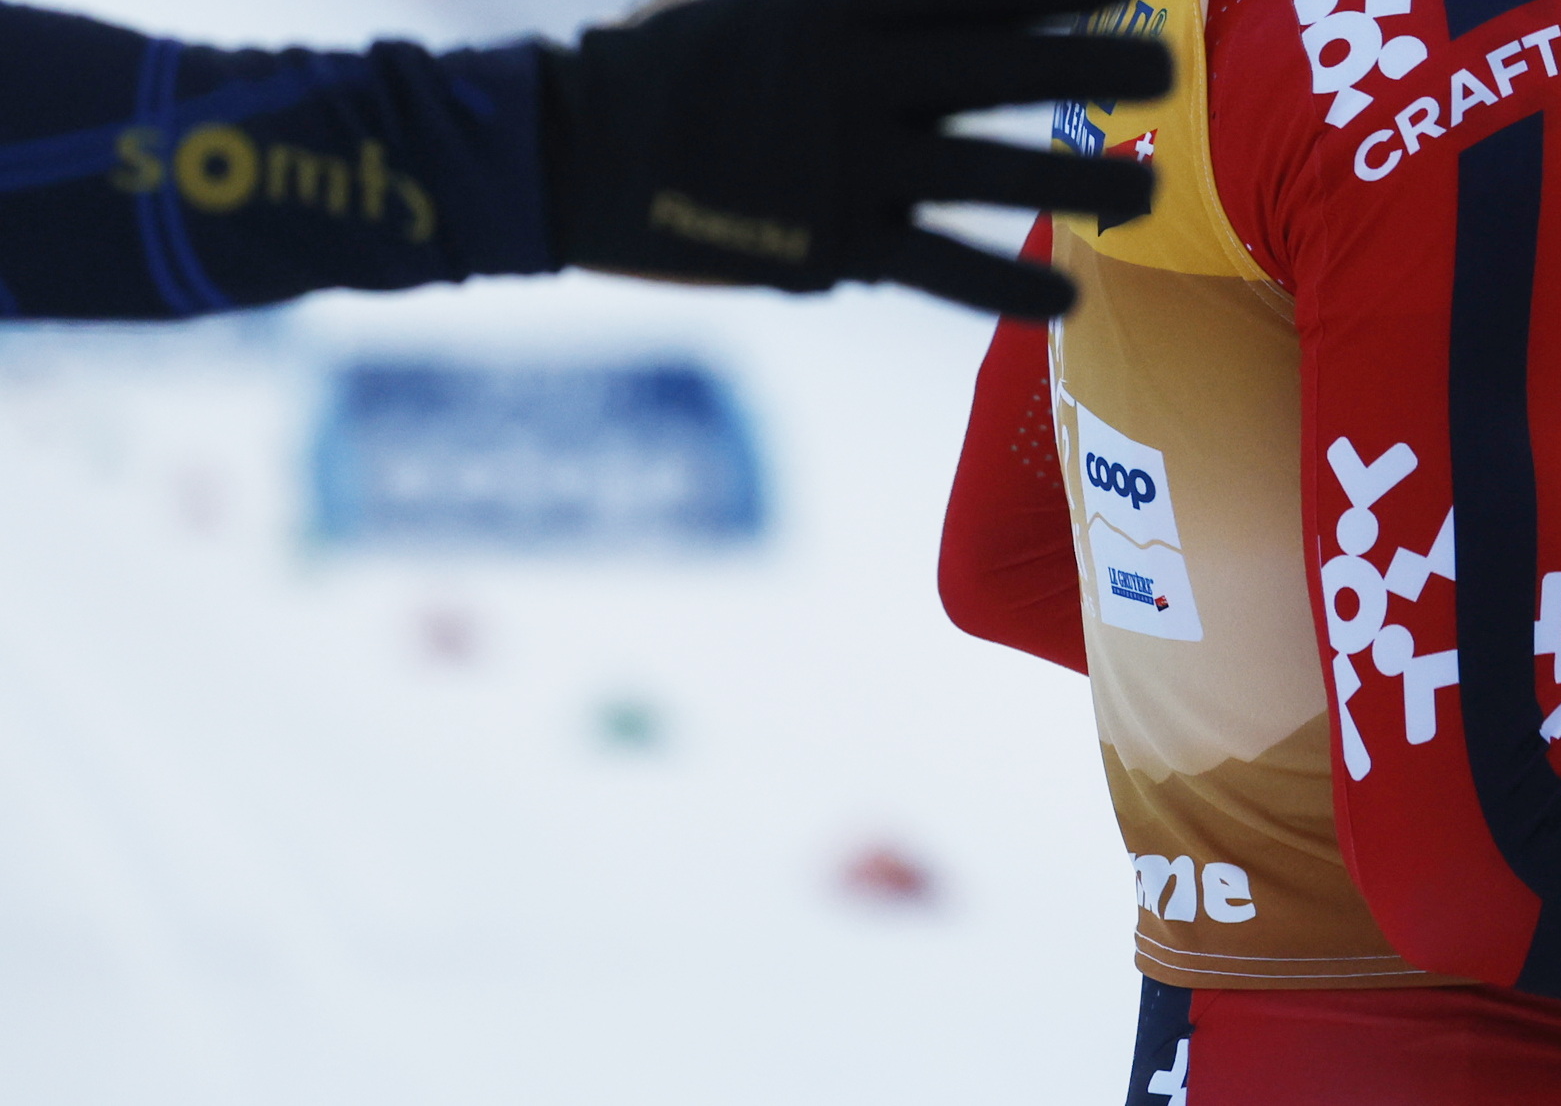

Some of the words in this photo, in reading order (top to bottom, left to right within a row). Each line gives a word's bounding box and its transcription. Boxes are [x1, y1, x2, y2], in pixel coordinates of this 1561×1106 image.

[1354, 24, 1561, 183] CRAFT
[1086, 452, 1156, 510] coop
[1129, 852, 1257, 924] me
